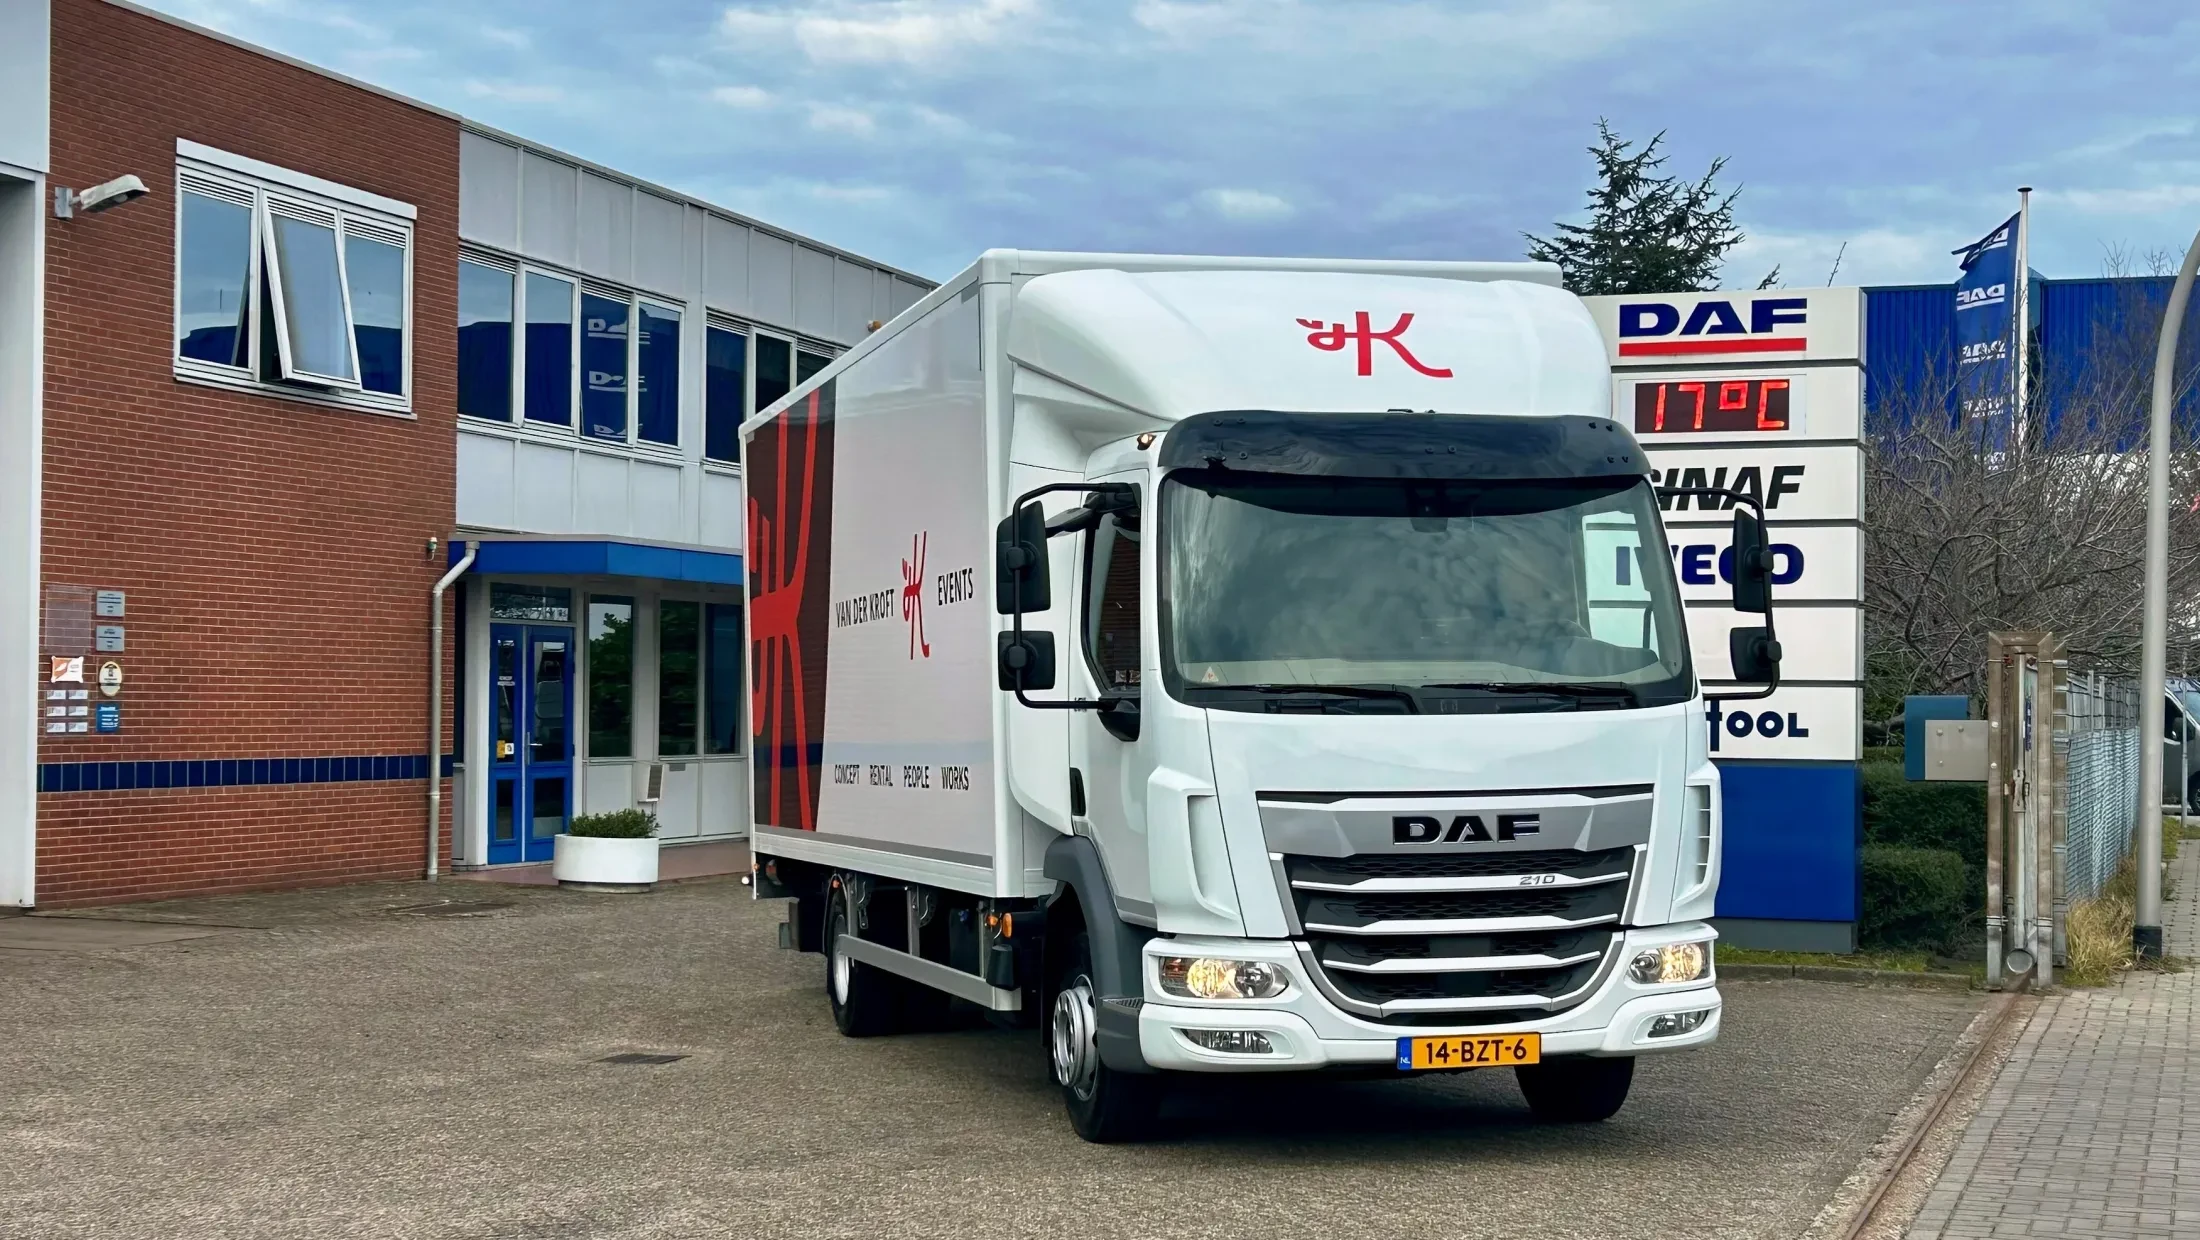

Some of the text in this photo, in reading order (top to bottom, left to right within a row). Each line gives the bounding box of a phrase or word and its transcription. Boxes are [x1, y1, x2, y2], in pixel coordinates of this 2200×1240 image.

[1619, 298, 1807, 337] DAF
[1615, 543, 1805, 585] IEO
[836, 600, 852, 628] VAN
[853, 595, 868, 625] DER
[869, 588, 895, 621] KROFT
[938, 567, 973, 606] EVENTS
[834, 764, 970, 791] CONCEPT RENTAL PEOPLE WORKS
[1392, 814, 1540, 845] DAF
[1520, 875, 1556, 886] 210
[1399, 1038, 1527, 1065] NL 14-BZT-6
